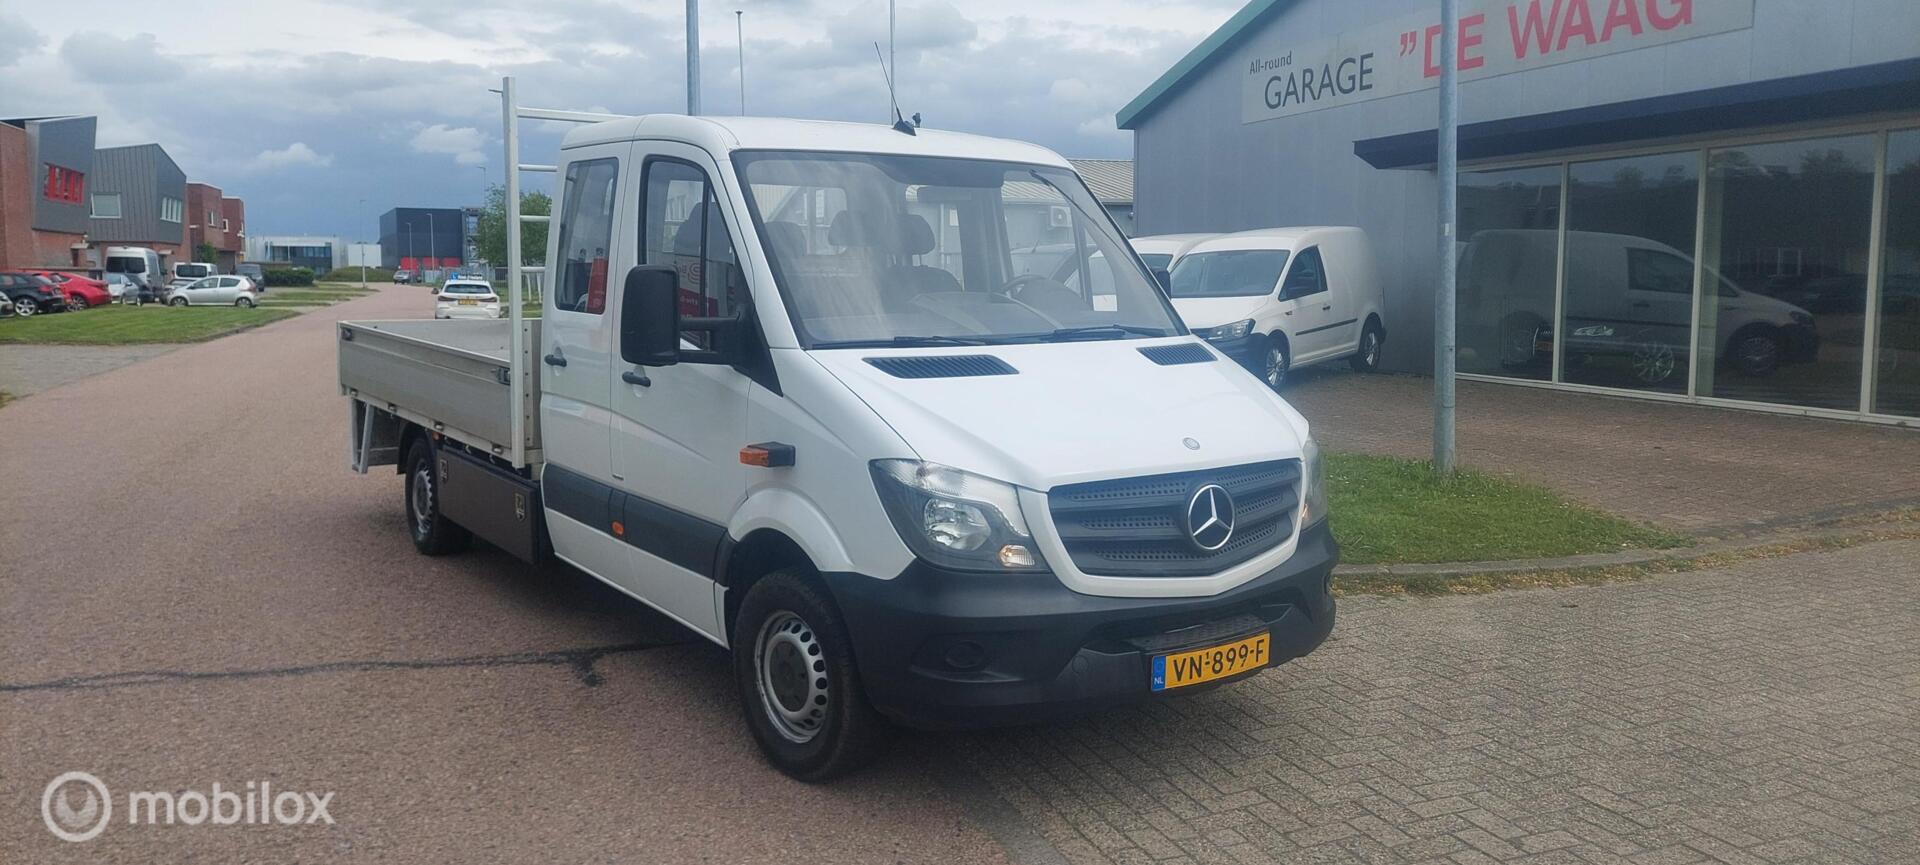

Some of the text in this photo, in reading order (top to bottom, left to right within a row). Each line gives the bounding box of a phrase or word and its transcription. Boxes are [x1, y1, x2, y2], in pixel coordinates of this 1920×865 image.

[1250, 50, 1292, 75] All-round
[1264, 52, 1374, 110] GARAGE
[1153, 638, 1265, 685] NL VN-899-F
